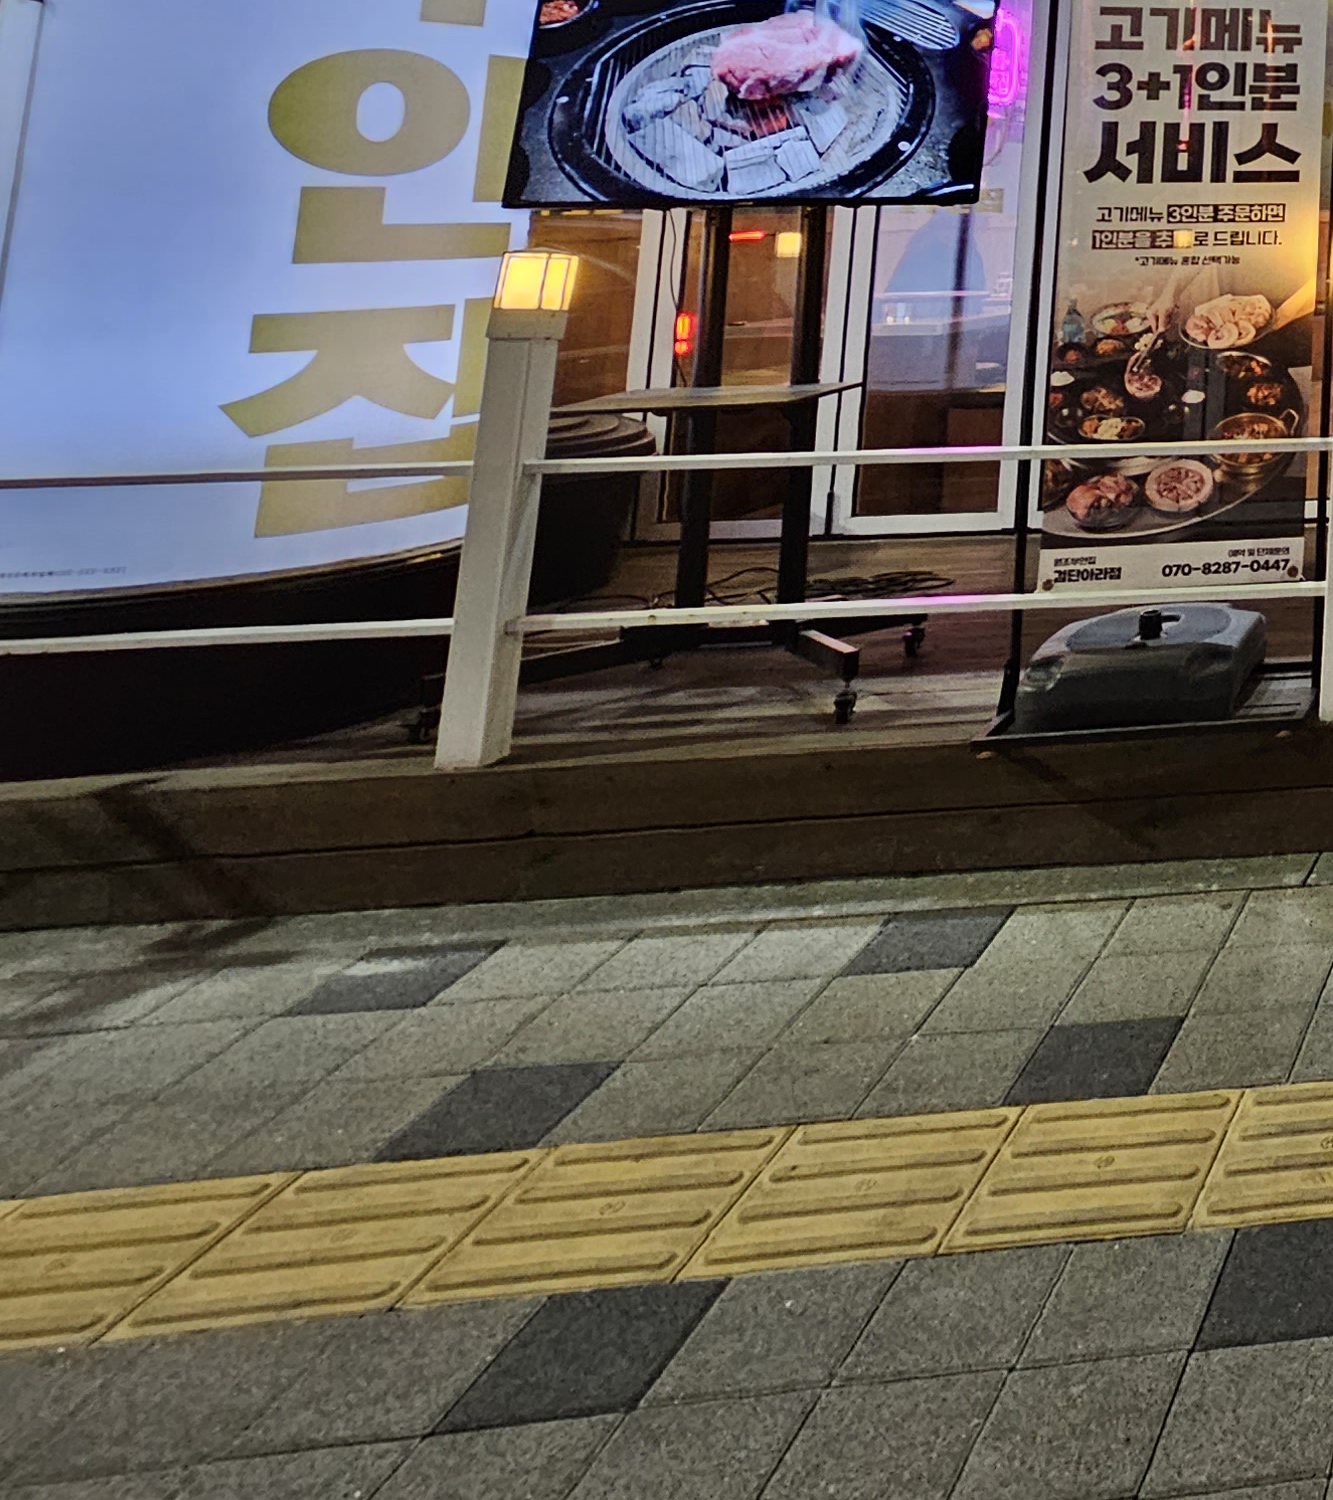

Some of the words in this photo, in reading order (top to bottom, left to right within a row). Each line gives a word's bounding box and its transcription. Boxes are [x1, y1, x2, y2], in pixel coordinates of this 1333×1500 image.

[1094, 6, 1303, 54] 고기메뉴
[1092, 61, 1300, 112] 3+1인분
[1083, 120, 1302, 184] 서비스
[1096, 206, 1164, 223] 고기메뉴
[1167, 205, 1214, 223] 3인분
[1217, 204, 1285, 223] 주문하면
[1092, 231, 1152, 249] 1인분을
[1154, 230, 1209, 248] 추로
[1212, 230, 1283, 246] 드립니다.
[1053, 566, 1123, 584] 검단아라점
[1161, 558, 1290, 577] 070-8287-0447
